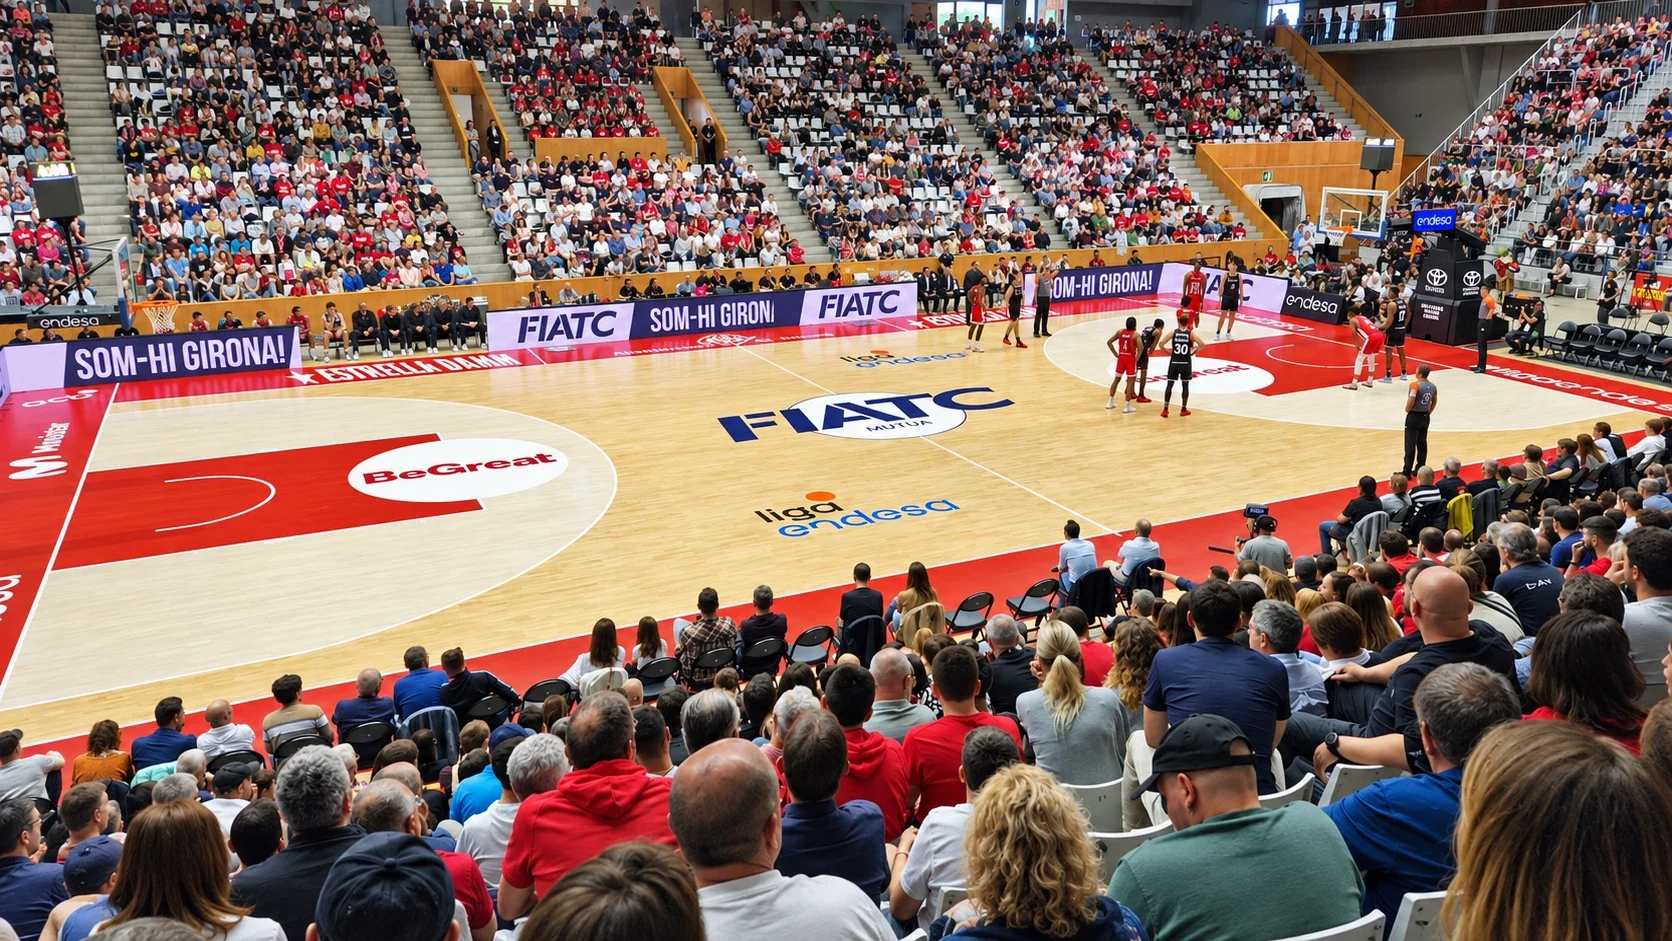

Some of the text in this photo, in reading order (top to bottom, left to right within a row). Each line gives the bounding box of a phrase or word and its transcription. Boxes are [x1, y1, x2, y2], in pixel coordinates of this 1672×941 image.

[1417, 214, 1452, 226] endesa
[1098, 270, 1153, 294] GIRONA!
[650, 299, 774, 333] SOM-HI GIRON
[818, 289, 901, 319] FIATC
[1286, 292, 1339, 316] endesa
[40, 316, 99, 329] endesa
[517, 310, 617, 344] FIATC
[74, 334, 286, 380] SOM-HI GIRONA!
[1173, 343, 1189, 355] 30
[315, 353, 522, 382] ESTRELLA DAMM
[717, 386, 1016, 443] FIATC
[866, 420, 934, 432] MUTUA
[362, 452, 558, 485] BeGreat
[754, 500, 844, 523] liga
[778, 499, 961, 538] endesa
